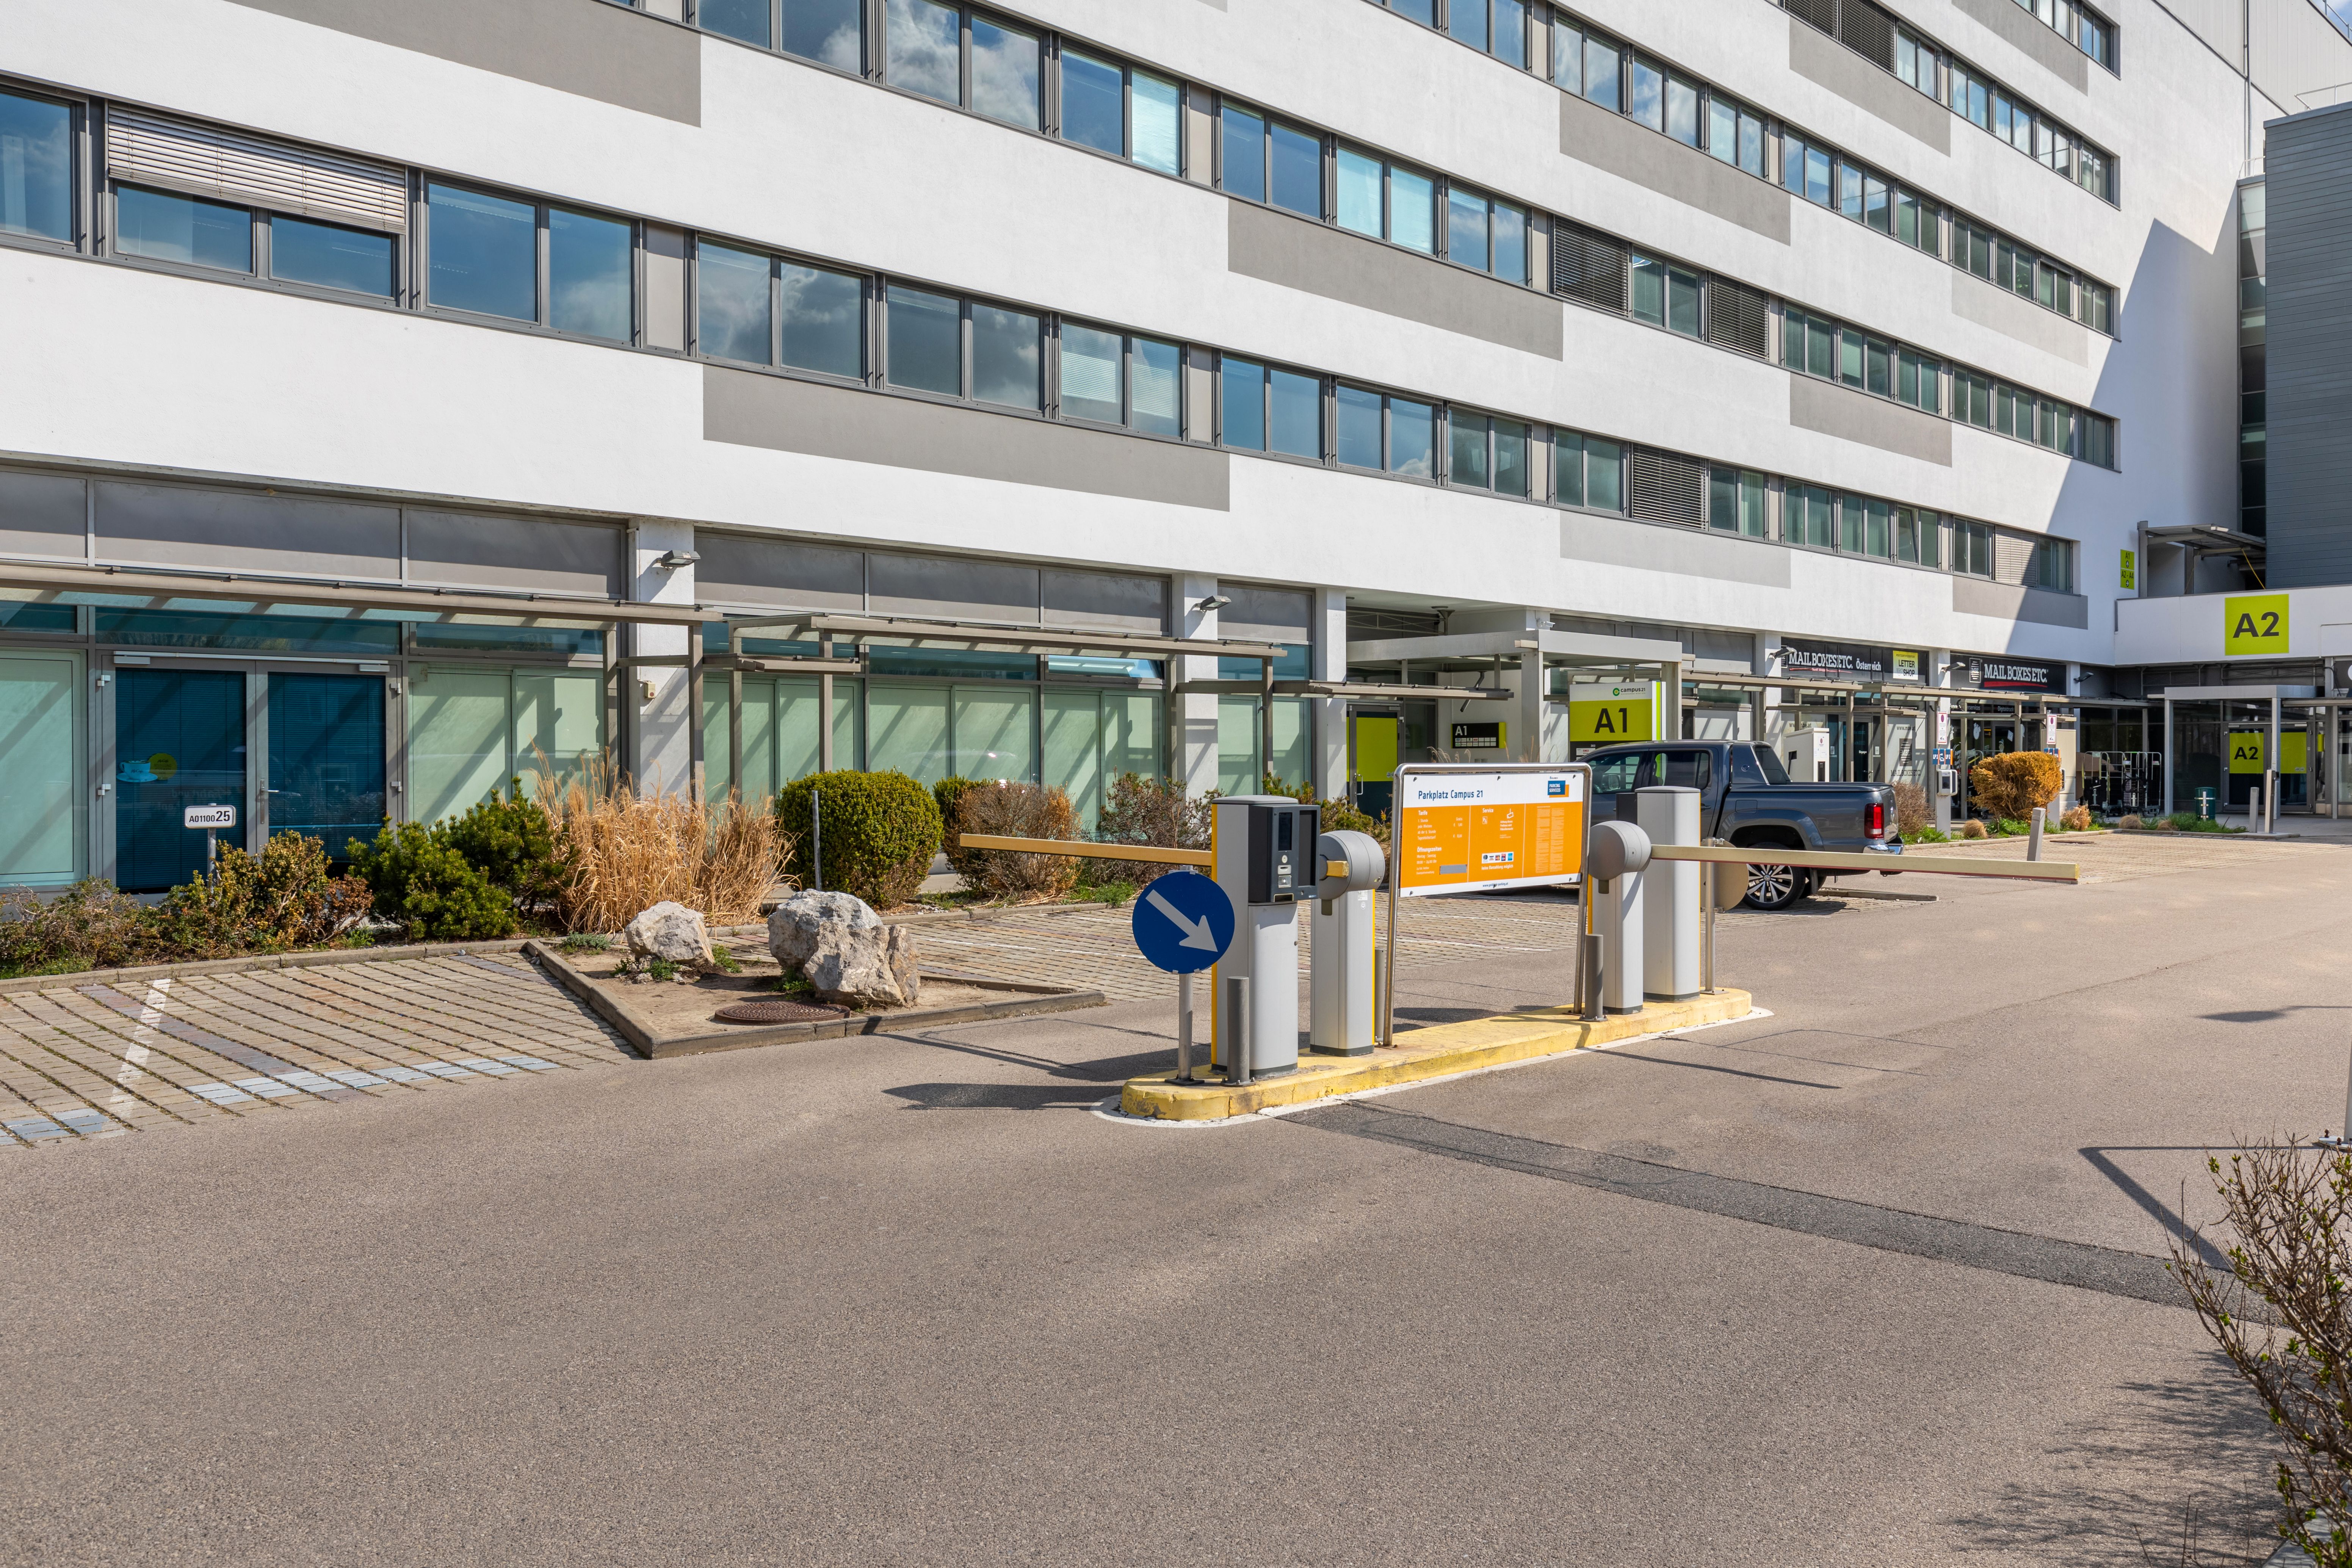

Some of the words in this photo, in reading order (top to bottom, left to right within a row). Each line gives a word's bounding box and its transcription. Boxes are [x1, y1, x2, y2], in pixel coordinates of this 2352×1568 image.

[2233, 611, 2279, 638] A2
[1789, 651, 1811, 666] MAIL
[1811, 653, 1838, 668] BOXES
[1856, 658, 1882, 671] Österreich
[1898, 659, 1915, 668] LETTER
[1903, 669, 1915, 677] SHOP
[1984, 664, 2006, 680] MAIL
[2007, 666, 2032, 681] BOXES
[1594, 708, 1627, 733] A1
[1455, 725, 1467, 736] A1
[2234, 746, 2258, 760] A2
[1418, 790, 1448, 801] Parkplatz
[1451, 789, 1474, 800] Campus
